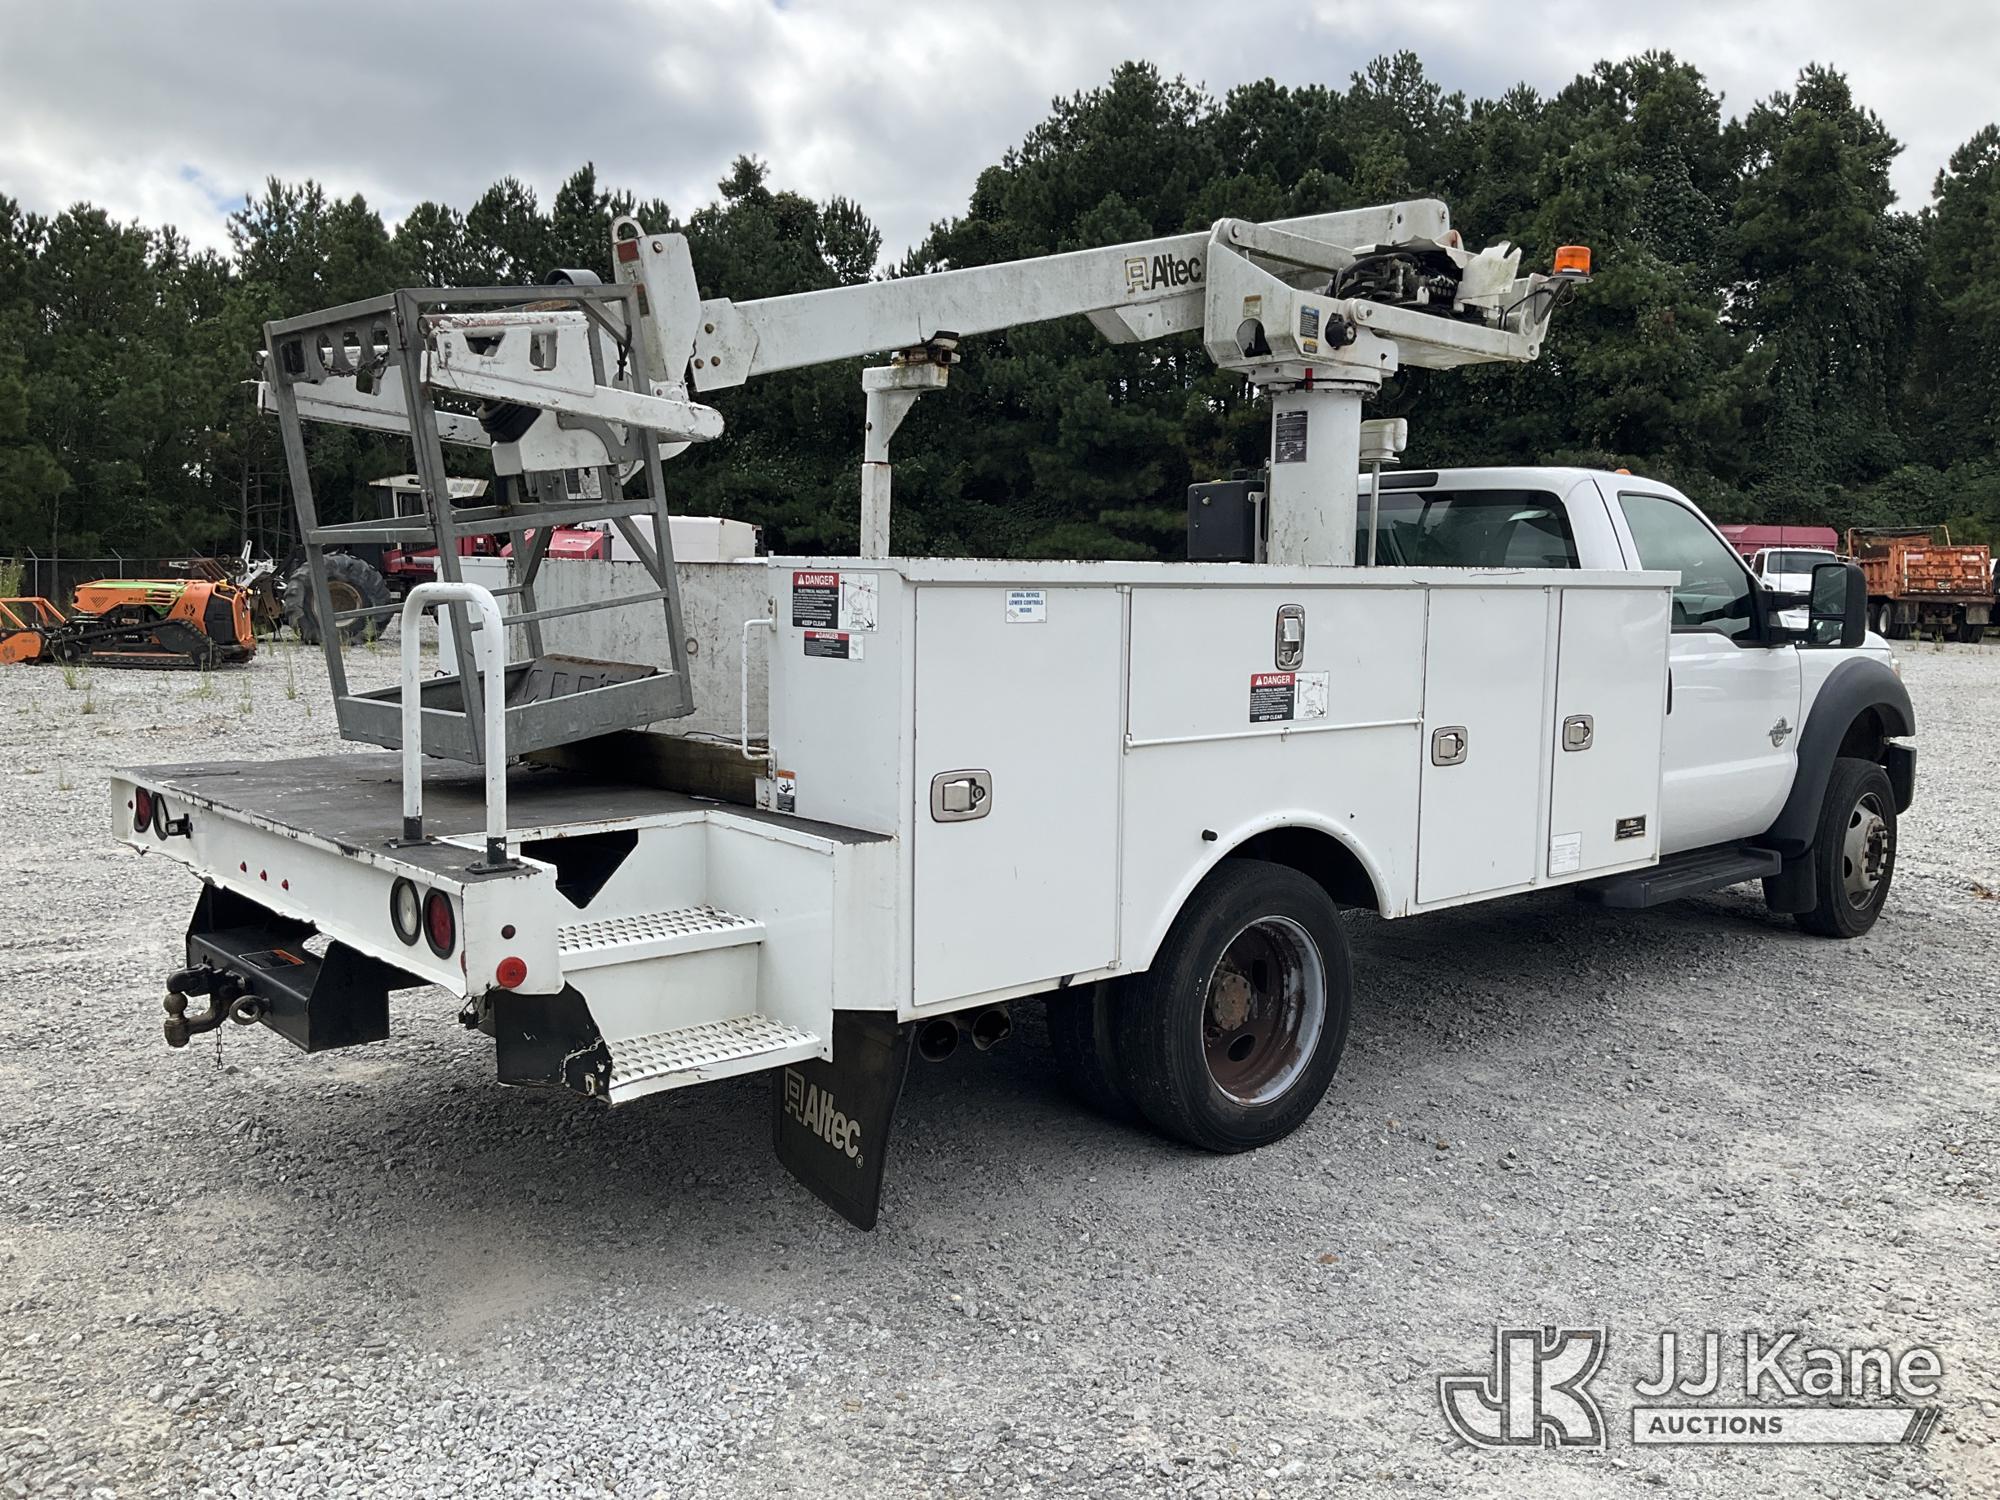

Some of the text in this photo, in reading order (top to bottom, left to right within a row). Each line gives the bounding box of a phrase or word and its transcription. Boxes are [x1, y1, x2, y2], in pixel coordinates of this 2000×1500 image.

[1151, 253, 1202, 290] Altec
[805, 574, 834, 586] DANGER
[1263, 675, 1290, 685] DANGER
[802, 1083, 861, 1158] Altec
